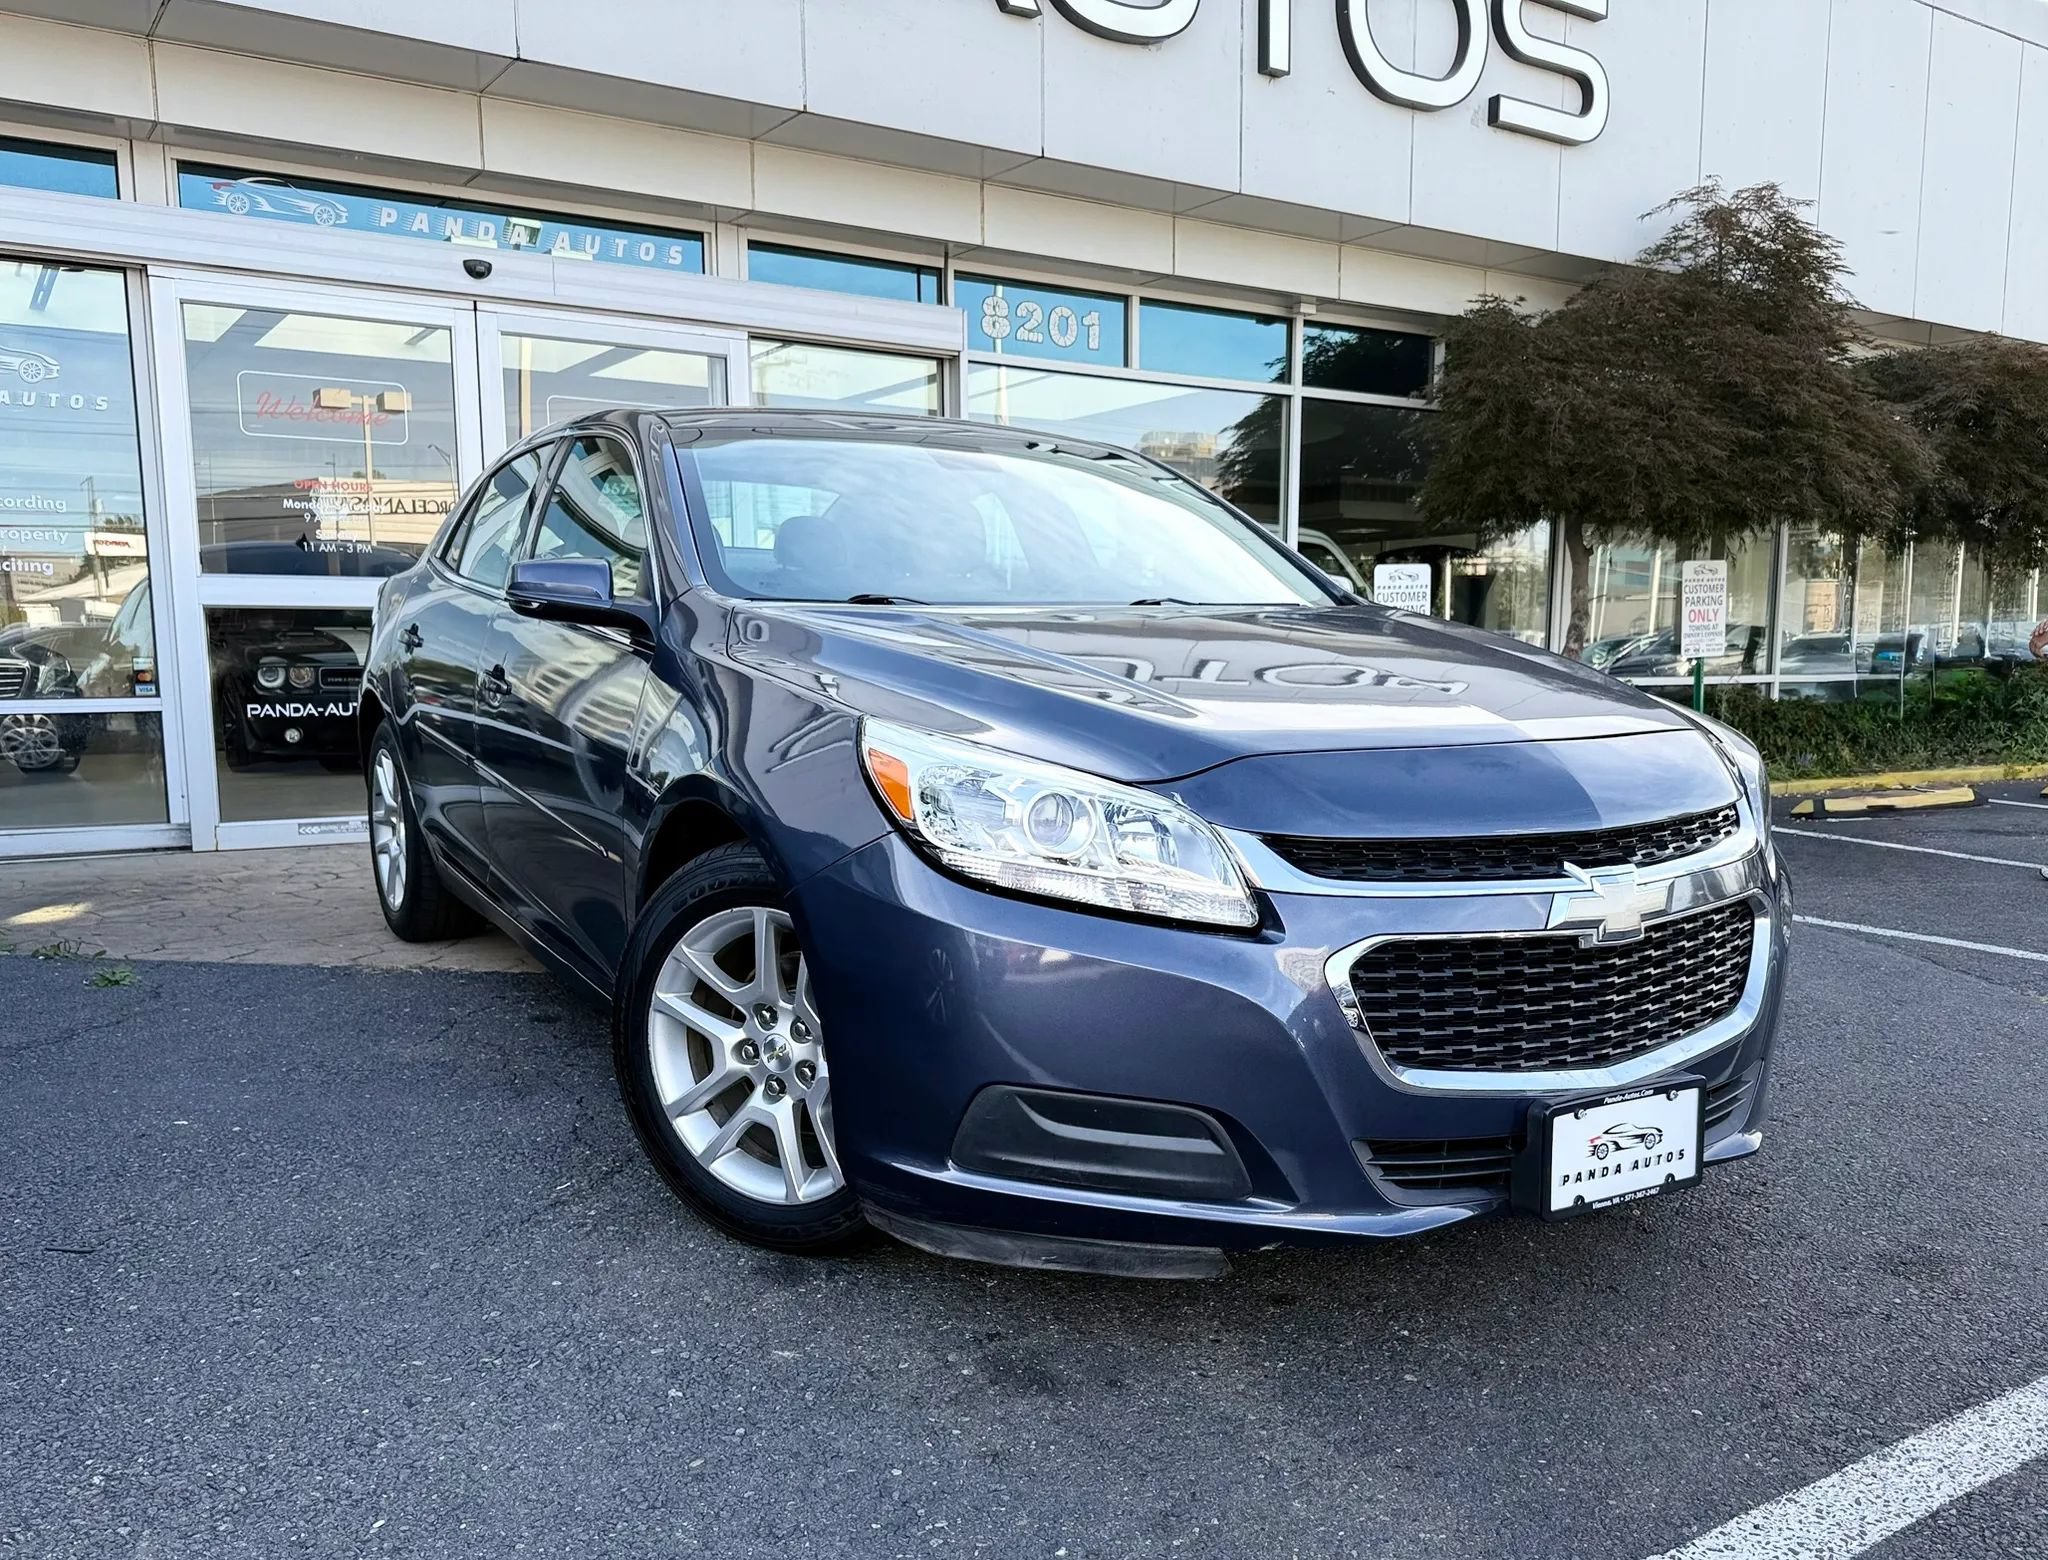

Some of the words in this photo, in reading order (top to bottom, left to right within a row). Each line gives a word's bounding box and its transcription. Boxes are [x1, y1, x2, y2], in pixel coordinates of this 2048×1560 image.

[378, 206, 530, 246] PANDA
[552, 230, 684, 265] AUTOS
[981, 295, 1100, 350] 8201
[256, 391, 391, 427] Welcome
[293, 479, 327, 490] OPEN
[331, 481, 373, 493] HOURS
[319, 542, 337, 552] AM
[346, 544, 354, 553] 3
[356, 544, 373, 554] PM
[1683, 583, 1725, 595] CUSTOMER
[1376, 591, 1428, 603] CUSTOMER
[1685, 595, 1723, 608] PARKING
[1688, 608, 1719, 623] ONLY
[1560, 1163, 1622, 1187] PANDA
[1628, 1149, 1686, 1172] AUTOS
